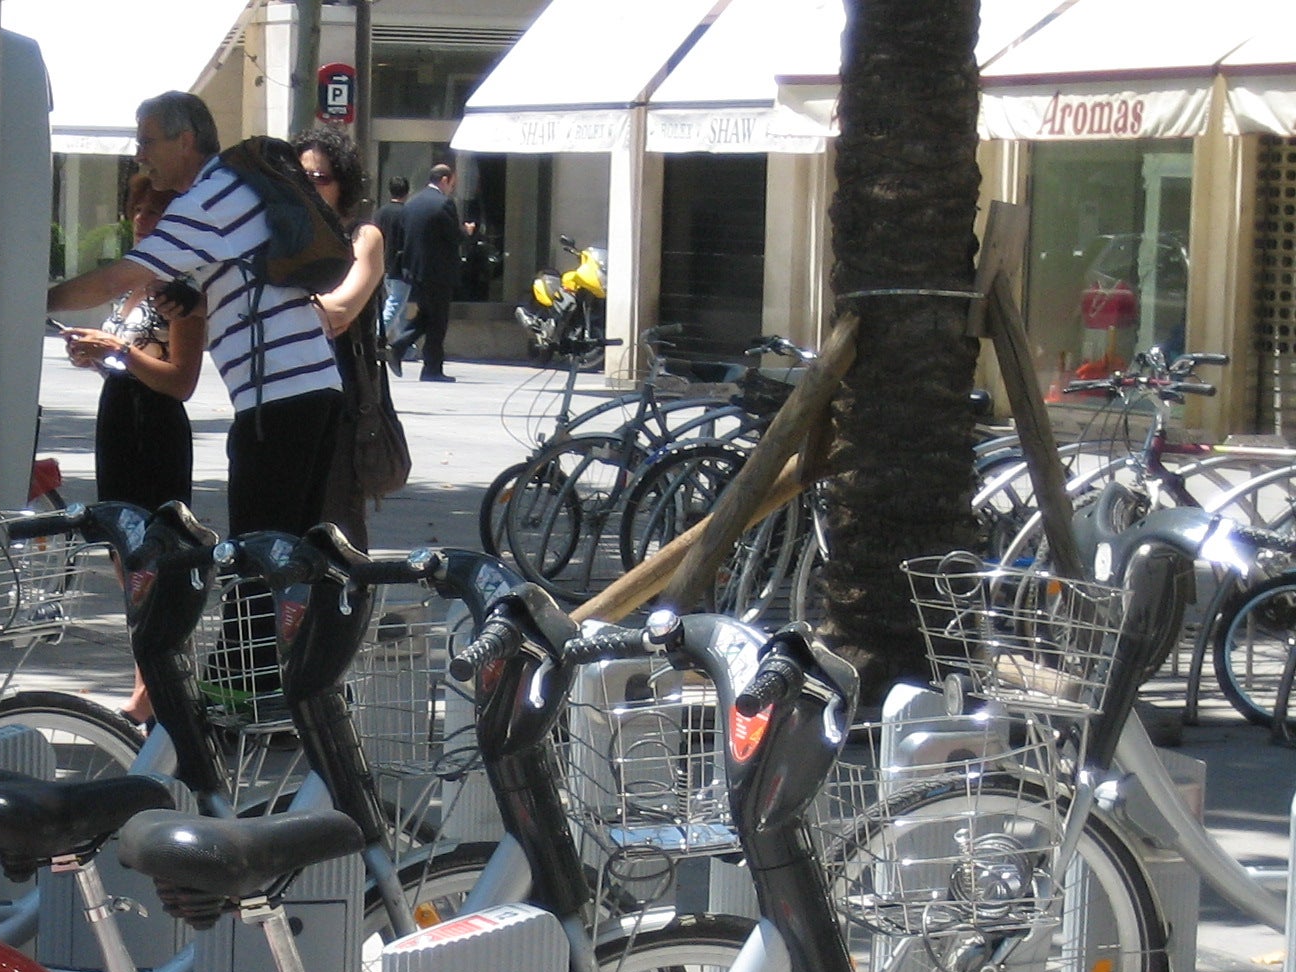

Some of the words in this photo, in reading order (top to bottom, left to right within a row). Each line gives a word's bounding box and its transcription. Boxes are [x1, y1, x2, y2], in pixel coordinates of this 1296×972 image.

[332, 87, 343, 102] P
[1036, 90, 1144, 135] Aromas
[708, 117, 757, 145] SHAW
